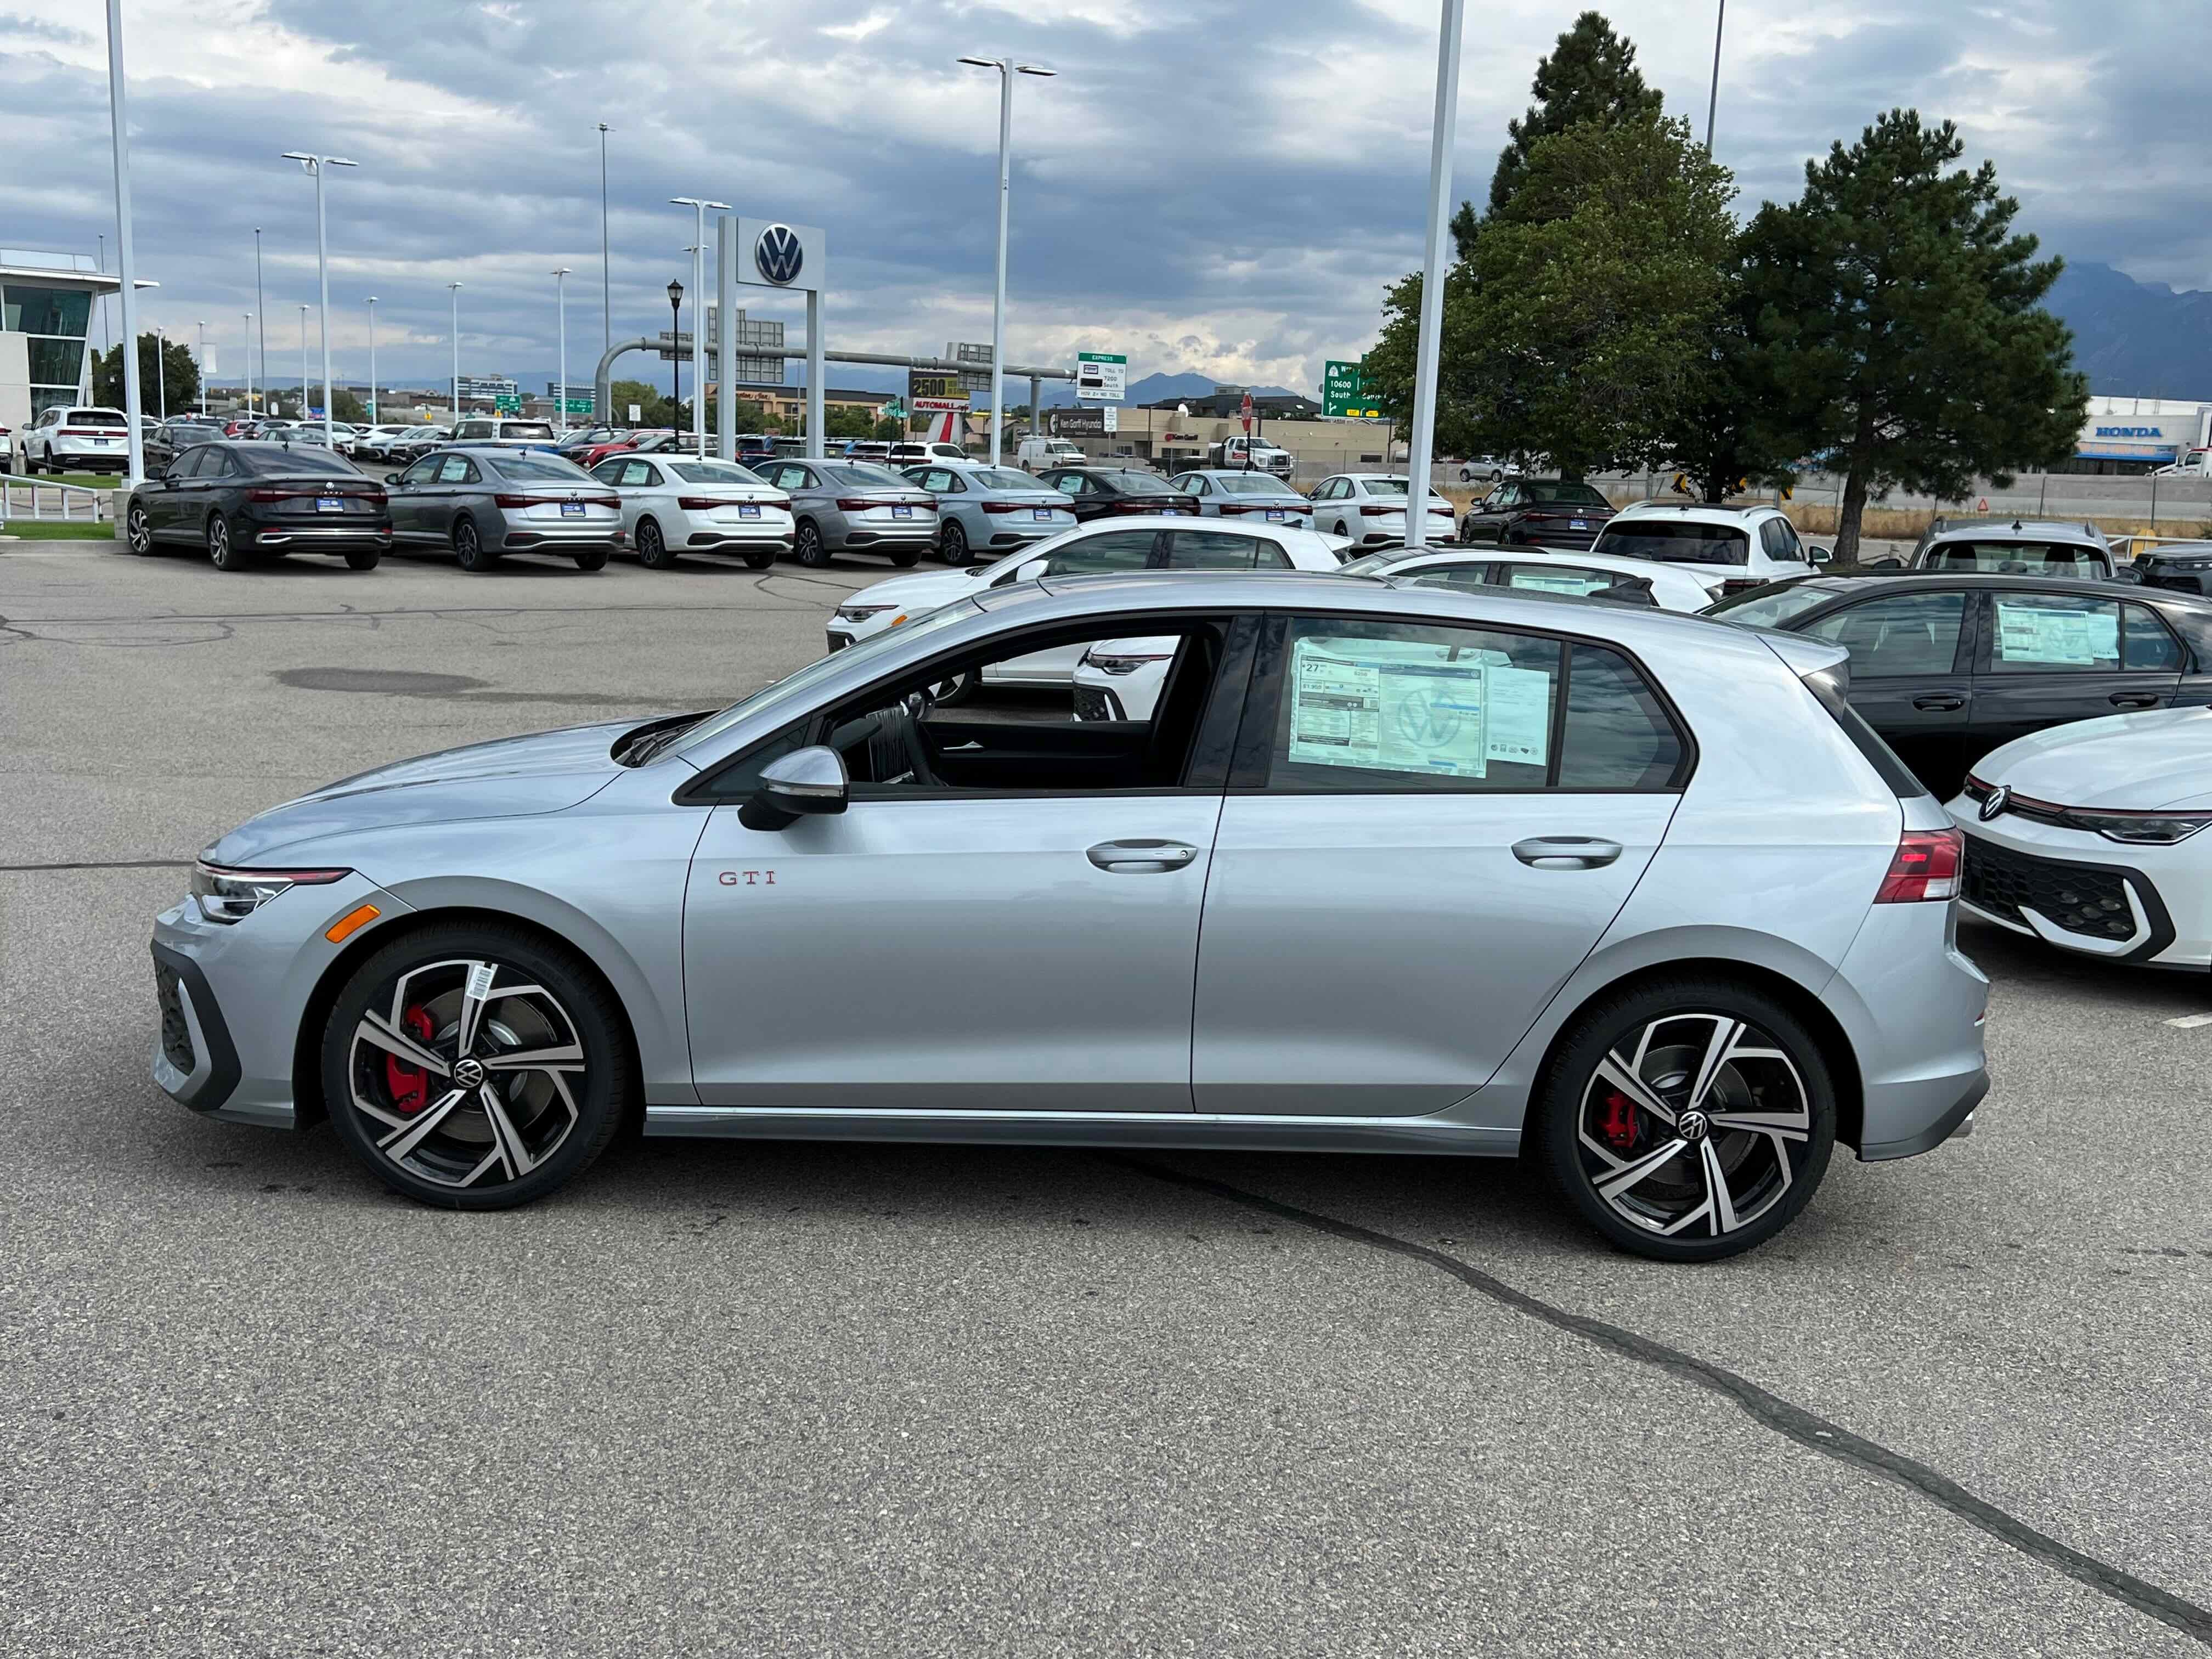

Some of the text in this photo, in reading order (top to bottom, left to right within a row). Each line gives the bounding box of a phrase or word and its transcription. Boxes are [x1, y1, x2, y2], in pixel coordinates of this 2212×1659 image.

[913, 379, 946, 396] 2500
[1330, 380, 1351, 388] 10600
[2096, 427, 2162, 437] HONDA
[1306, 664, 1319, 672] 27
[719, 871, 776, 885] GTI
